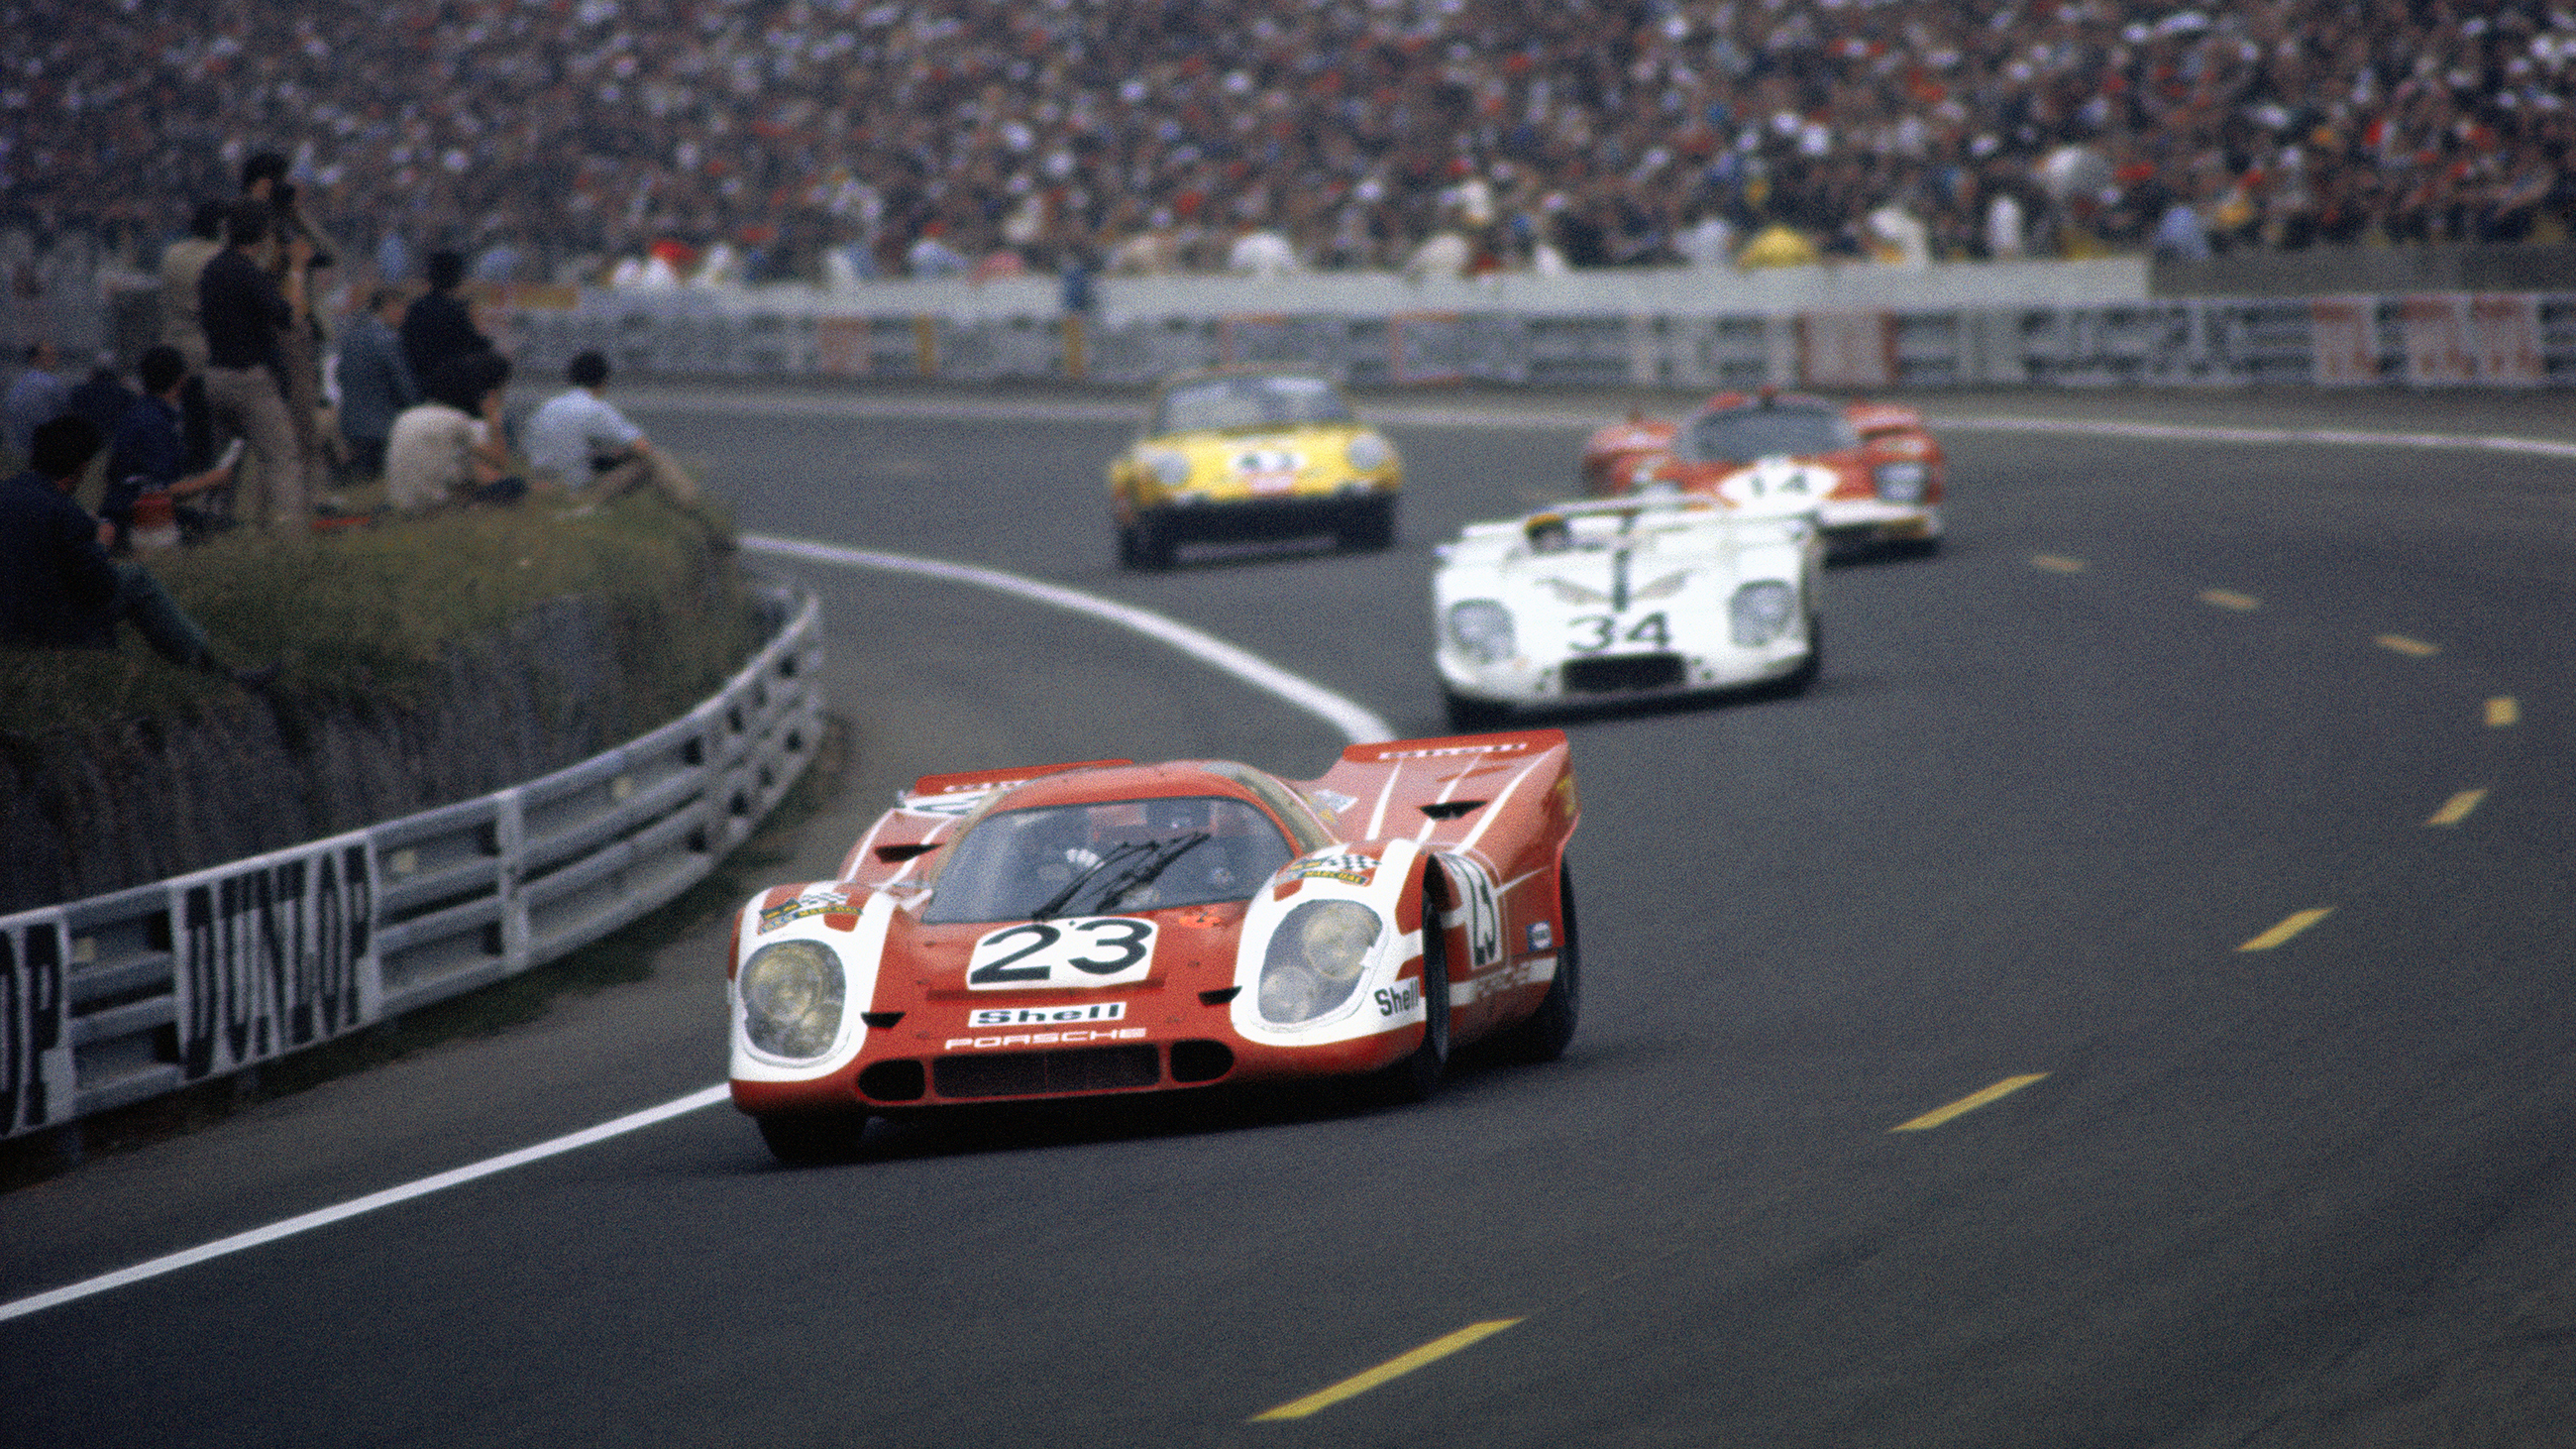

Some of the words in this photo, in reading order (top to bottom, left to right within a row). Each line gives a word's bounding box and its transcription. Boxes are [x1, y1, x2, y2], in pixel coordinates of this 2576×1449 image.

[1750, 471, 1811, 497] 14
[1567, 612, 1670, 652] 34
[185, 844, 368, 1080] DUNLOP
[969, 918, 1152, 985] 23
[978, 1003, 1120, 1025] Shell
[1374, 979, 1419, 1017] Shell
[944, 1027, 1147, 1051] PORSCHE
